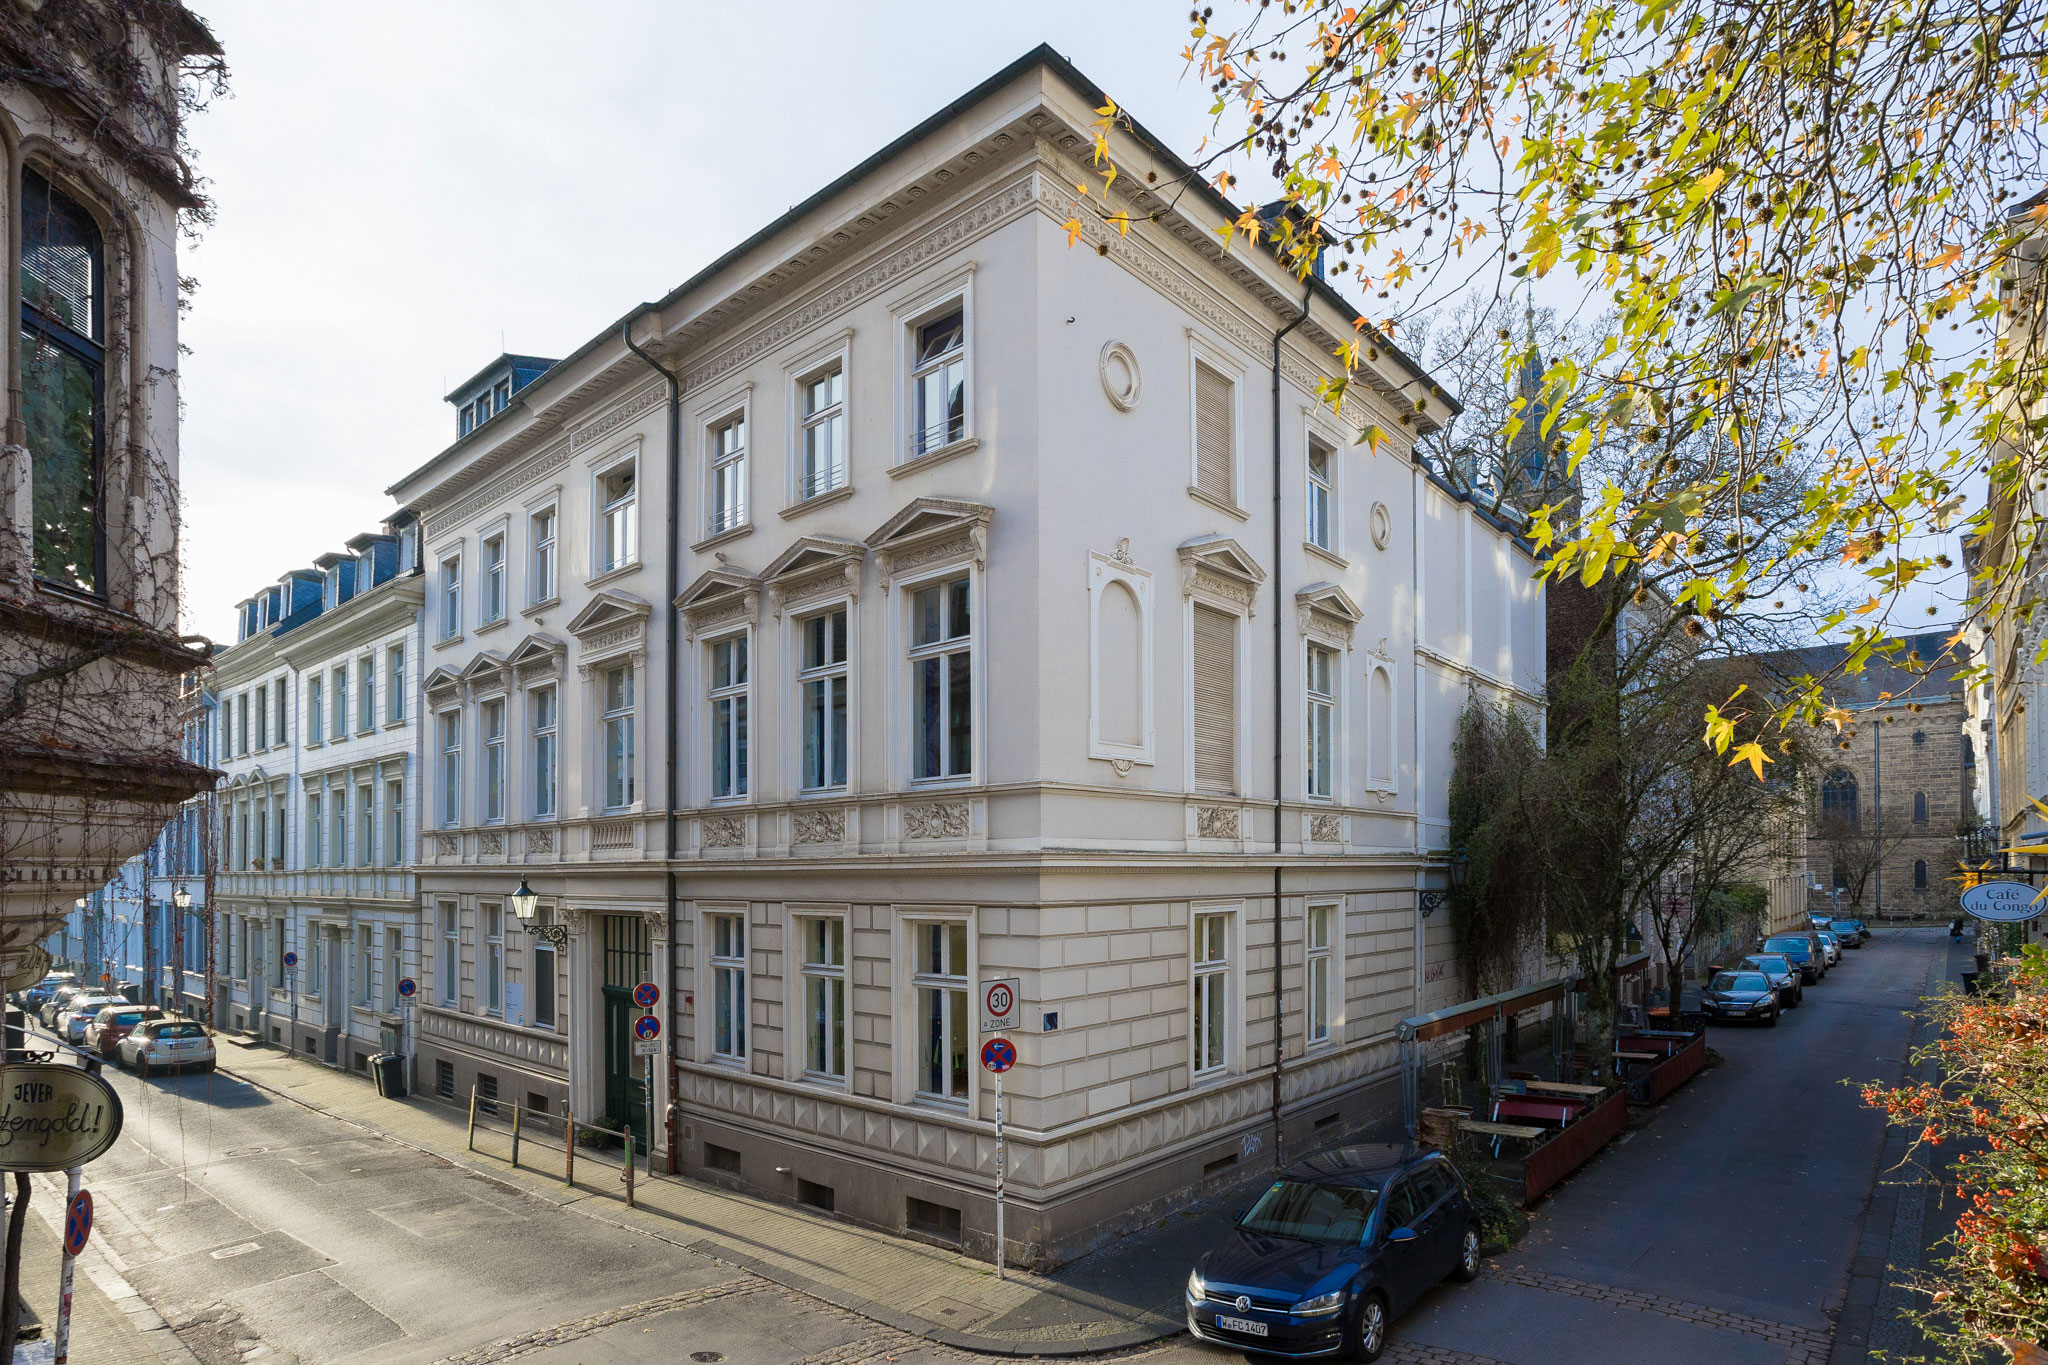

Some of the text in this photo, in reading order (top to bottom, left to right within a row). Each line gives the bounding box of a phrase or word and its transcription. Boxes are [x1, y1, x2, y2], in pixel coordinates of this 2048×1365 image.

[1986, 888, 2020, 900] Café
[1970, 900, 2038, 914] du Congo
[992, 992, 1008, 1008] 30
[990, 1018, 1011, 1028] ZONE
[14, 1082, 53, 1104] JEVER
[1245, 1322, 1267, 1335] 1407
